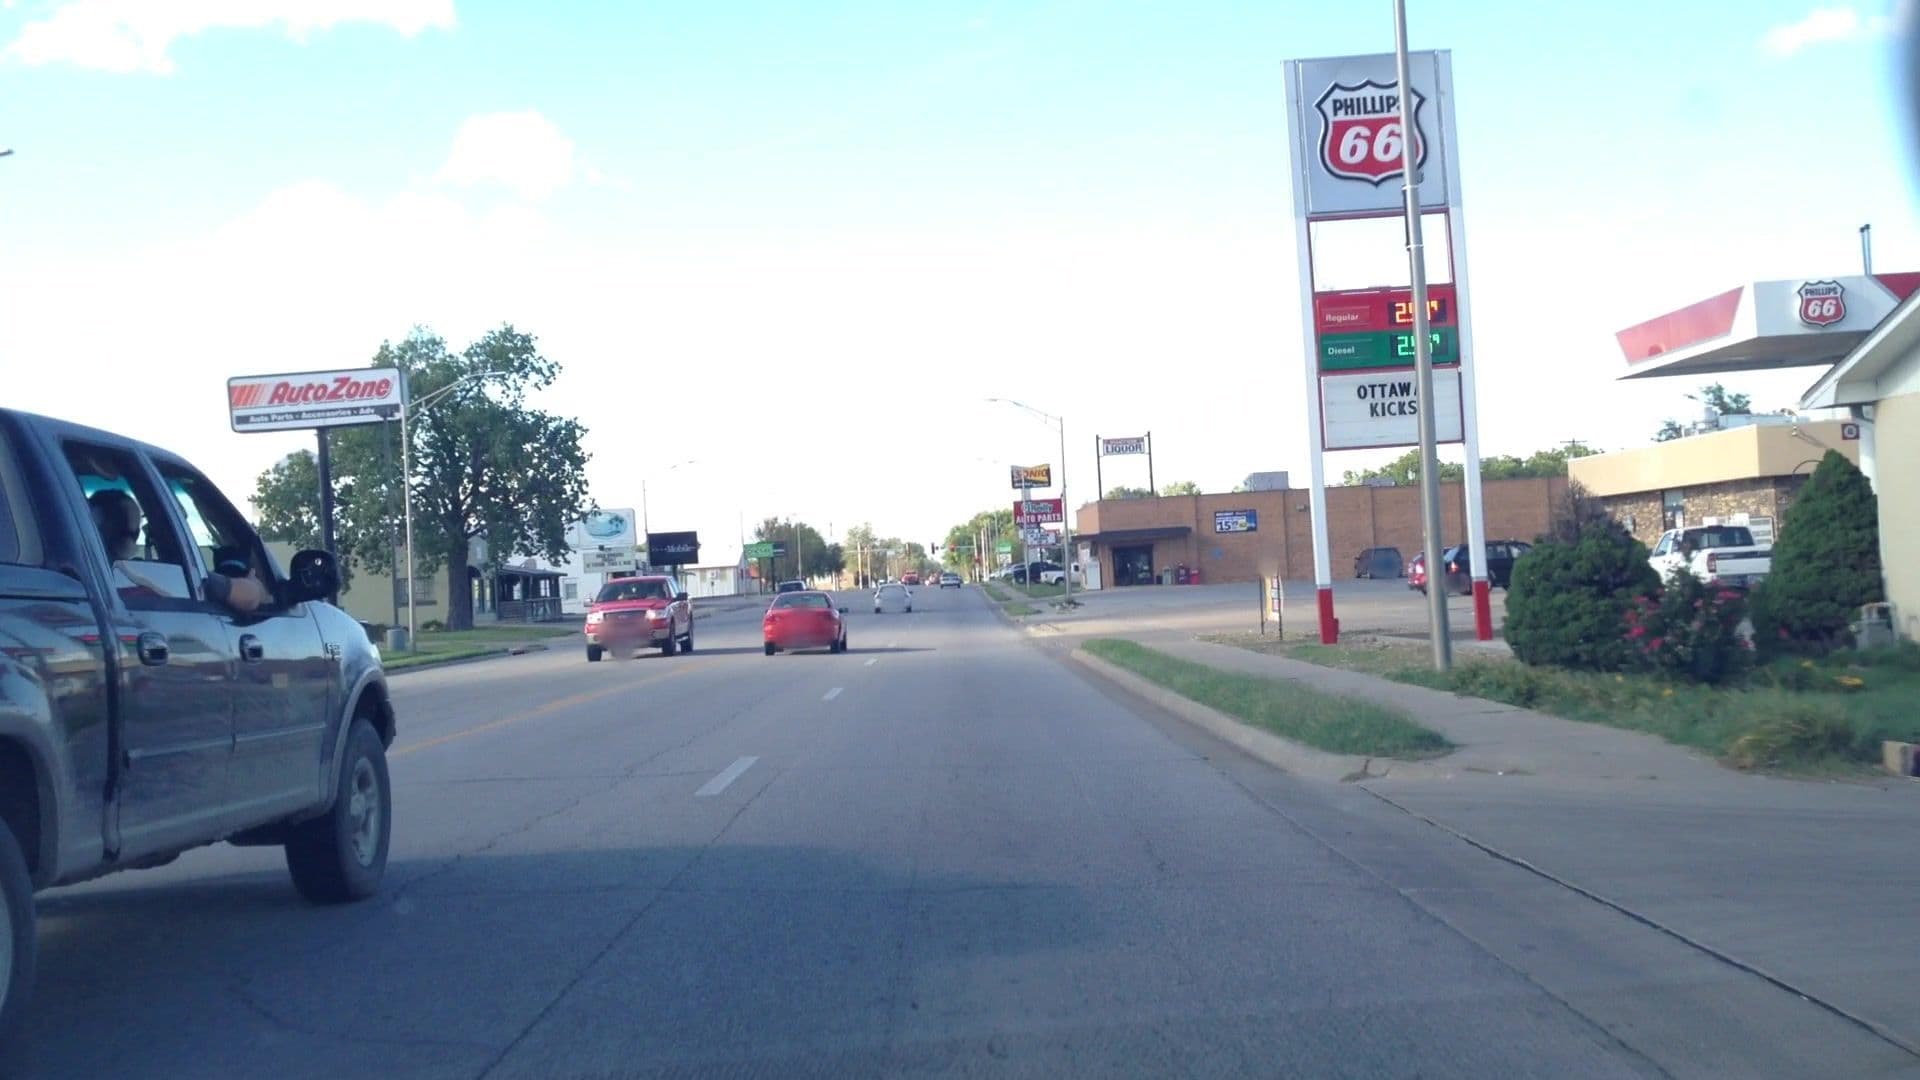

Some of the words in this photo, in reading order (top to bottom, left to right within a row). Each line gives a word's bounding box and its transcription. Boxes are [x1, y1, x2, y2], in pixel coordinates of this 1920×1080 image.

[1339, 123, 1402, 164] 66
[1805, 287, 1838, 296] PHILLIPS
[1808, 299, 1837, 317] 66
[1325, 313, 1359, 323] Regular
[1328, 346, 1355, 355] Diesel
[268, 377, 391, 404] AutoZone
[1357, 382, 1417, 400] OTTAW
[1370, 400, 1417, 417] KICKS
[249, 414, 268, 423] Auto
[271, 412, 294, 422] Parts
[301, 409, 352, 419] Accessories
[1106, 443, 1142, 453] LIQUOR
[1037, 513, 1061, 522] PARTS
